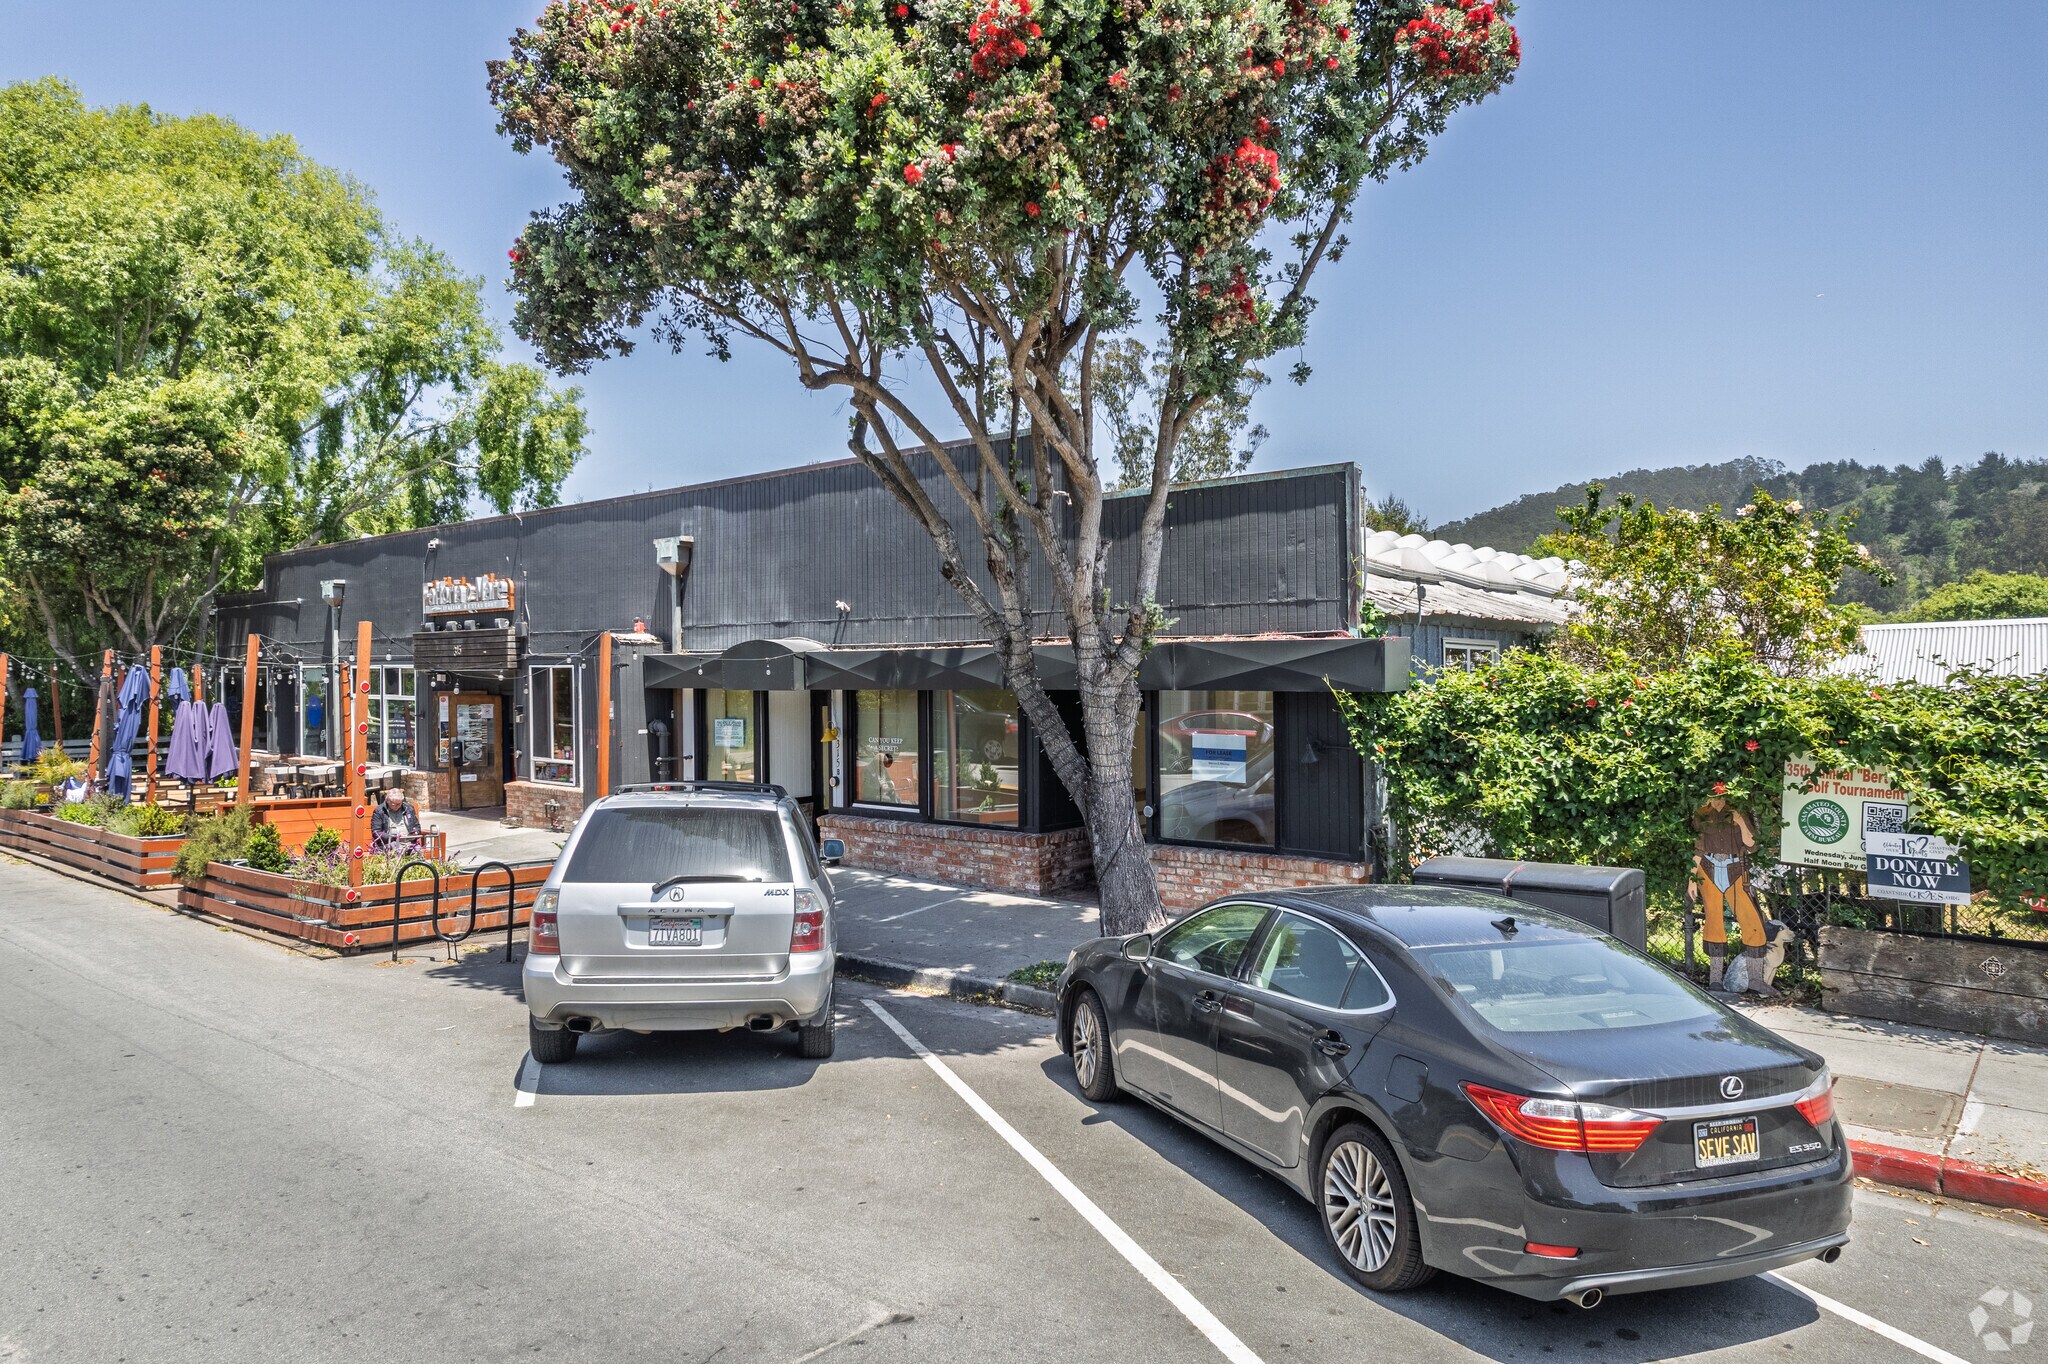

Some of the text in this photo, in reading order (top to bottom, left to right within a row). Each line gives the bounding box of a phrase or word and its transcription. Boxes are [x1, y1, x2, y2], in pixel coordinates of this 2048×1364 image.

[1833, 781, 1905, 800] Tournament
[1807, 801, 1830, 811] MATEO
[1830, 804, 1847, 828] COUNTY
[1802, 825, 1818, 840] FARM
[1804, 849, 1847, 860] Wednesday,
[1848, 854, 1867, 862] June
[1821, 859, 1842, 867] Moon
[1844, 861, 1859, 870] Bay
[1875, 857, 1959, 877] DONATE
[1892, 873, 1941, 889] NOW
[764, 888, 790, 896] MDX
[661, 920, 691, 929] California
[653, 928, 699, 942] 7TVA801
[1710, 1124, 1743, 1134] CALIFORNIA
[1698, 1132, 1756, 1159] SEVE SAV
[1789, 1141, 1822, 1154] ES 350
